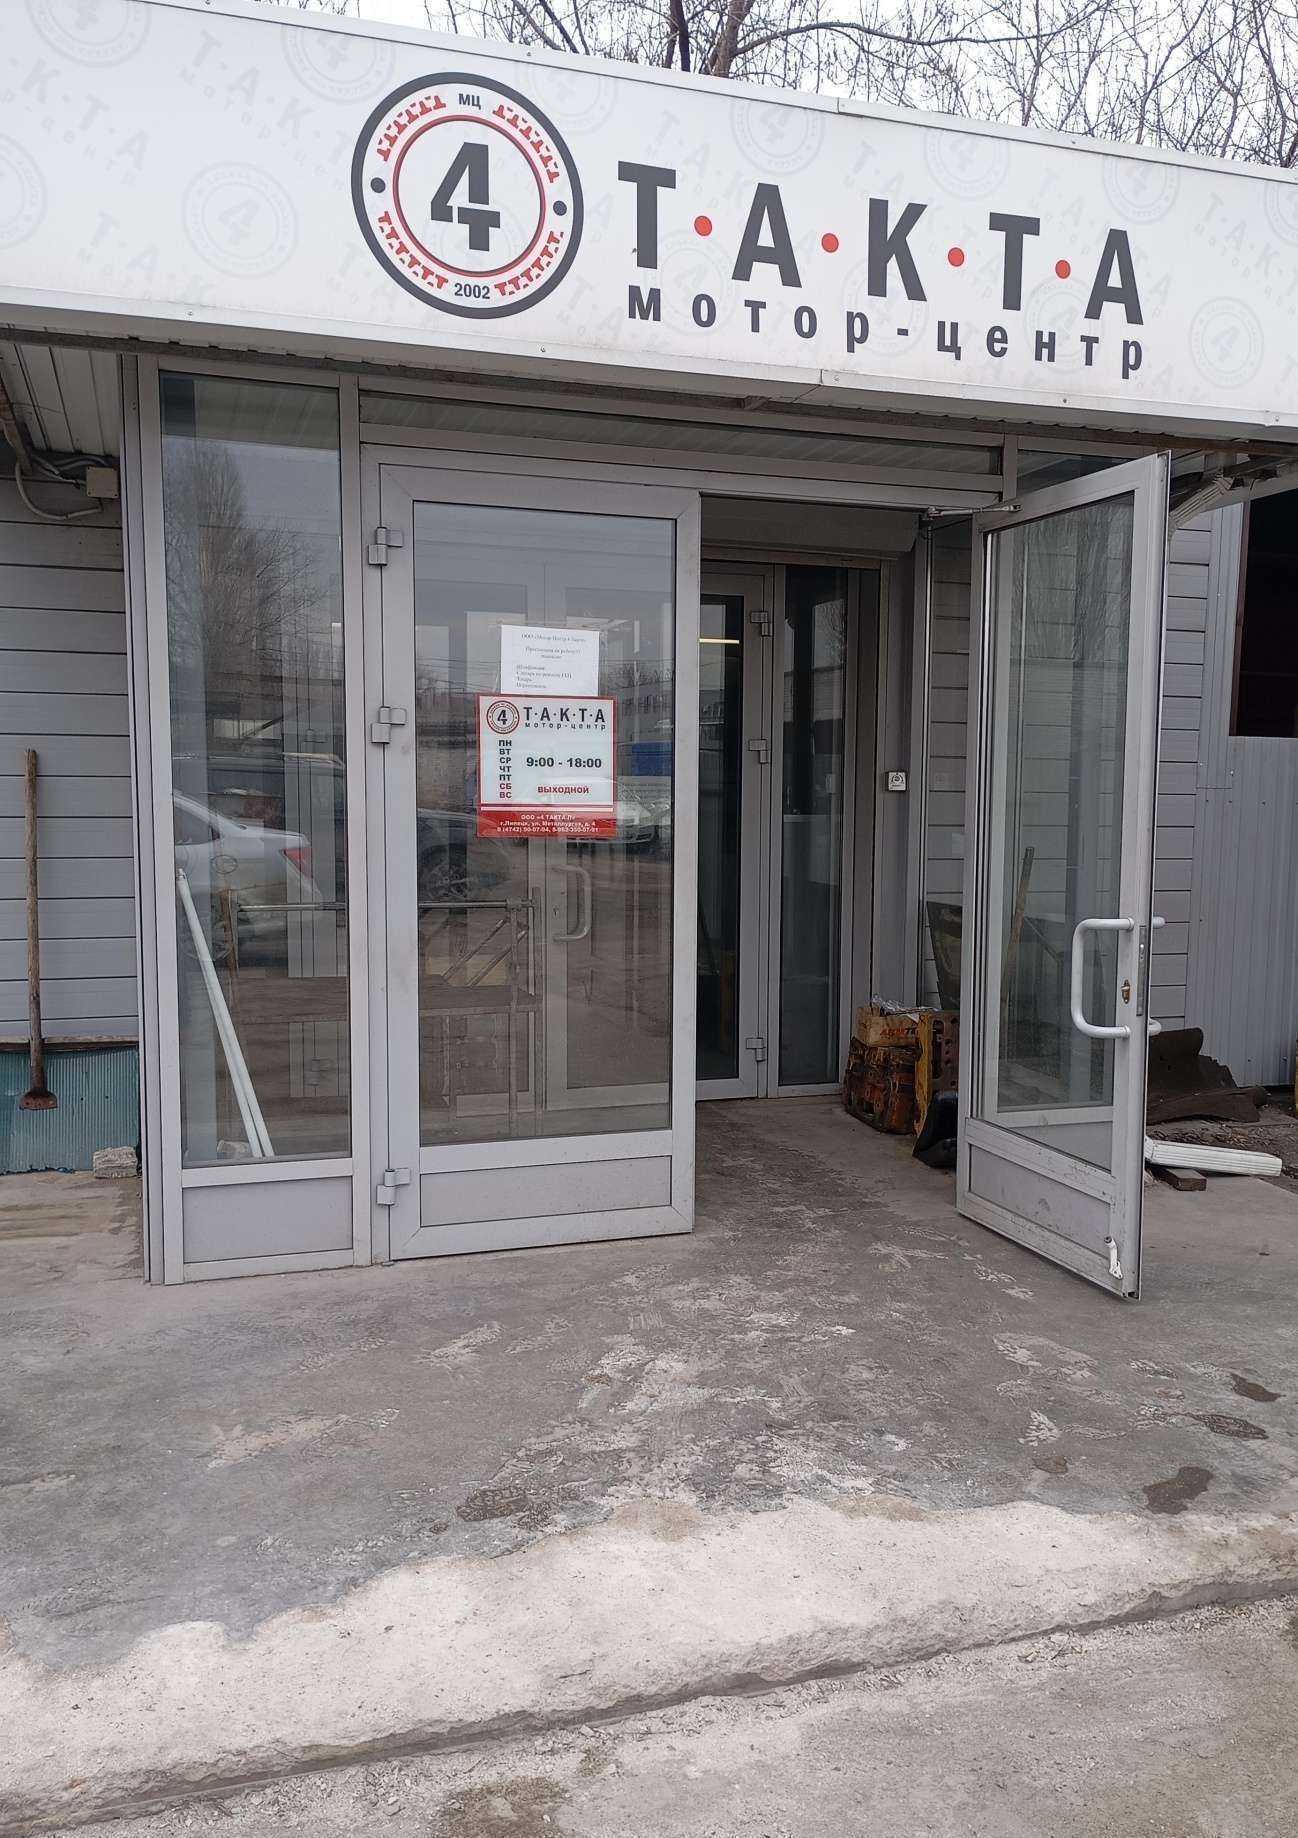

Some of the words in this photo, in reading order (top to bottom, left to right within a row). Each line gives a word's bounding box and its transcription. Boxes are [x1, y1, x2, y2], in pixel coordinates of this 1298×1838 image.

[458, 93, 482, 110] МЦ
[454, 283, 491, 299] 2002
[629, 285, 1142, 379] мотор-центр
[525, 722, 606, 730] мотор-центр
[526, 757, 554, 767] 9:00
[567, 758, 602, 768] 18:00
